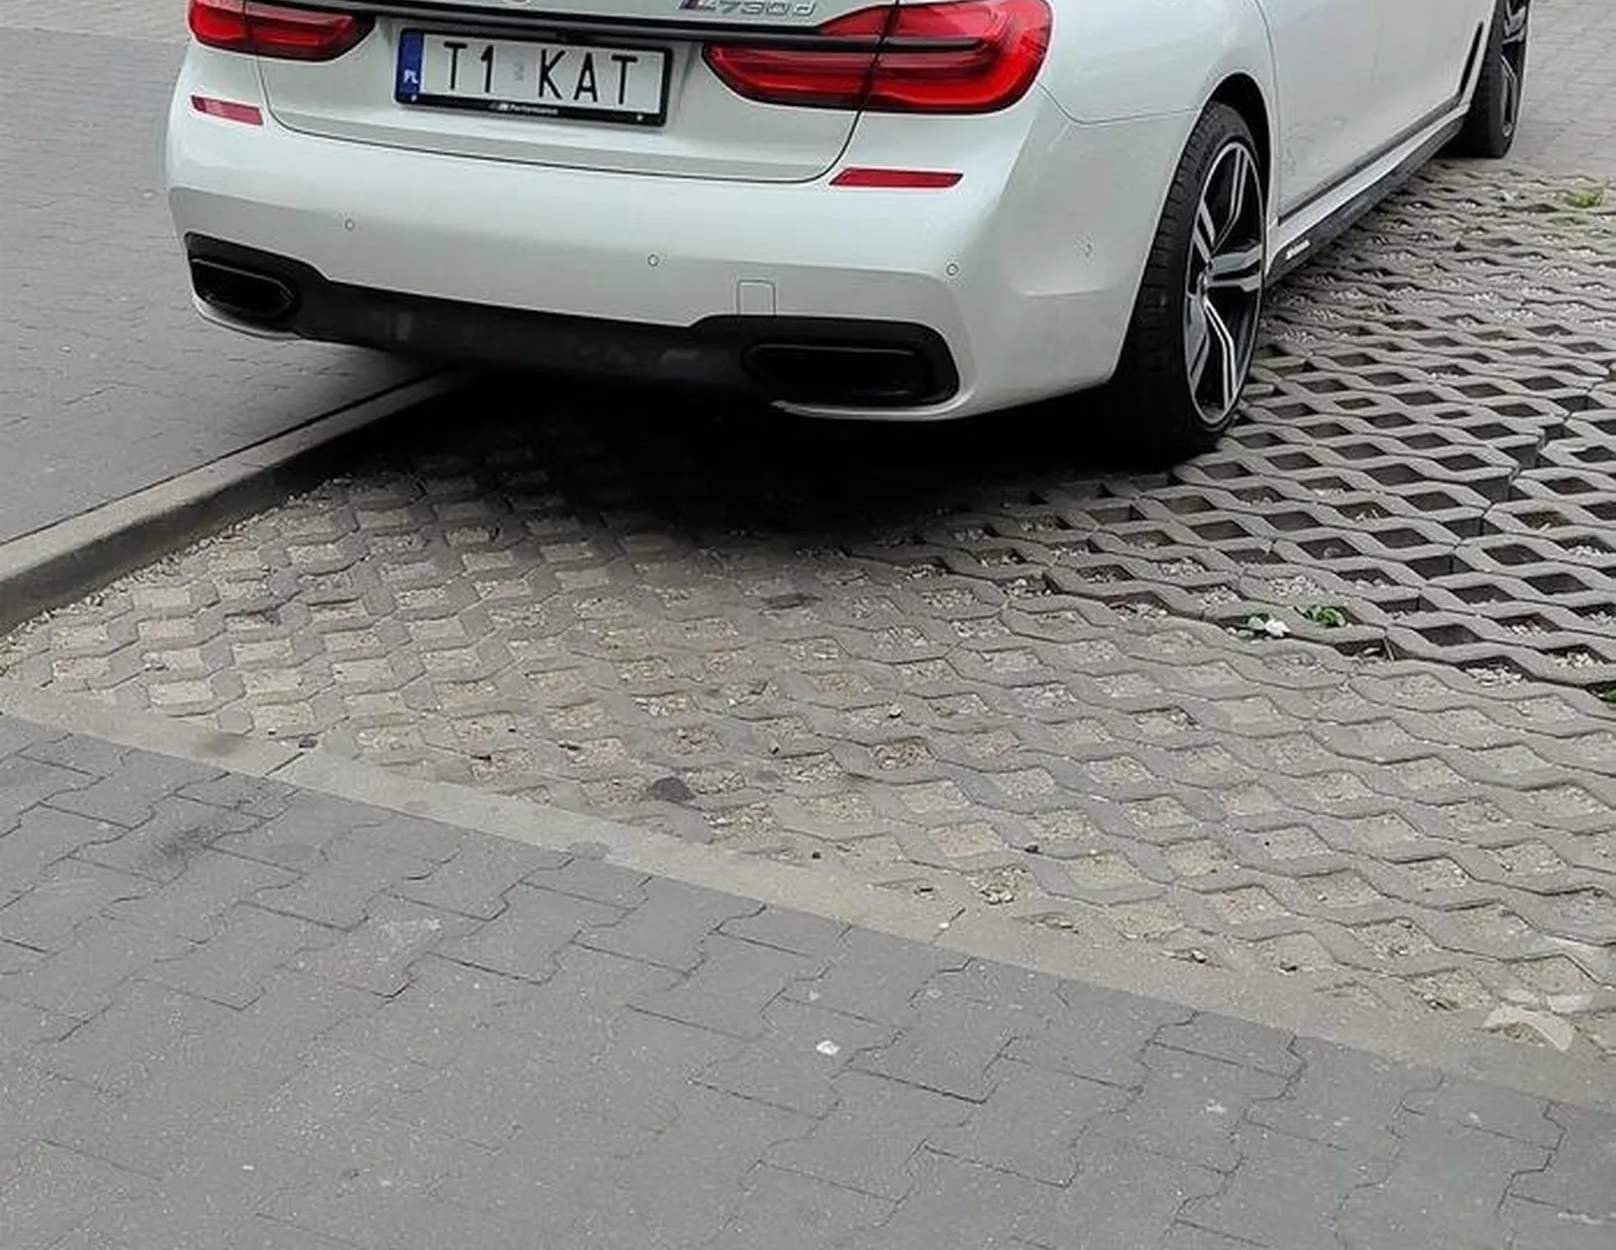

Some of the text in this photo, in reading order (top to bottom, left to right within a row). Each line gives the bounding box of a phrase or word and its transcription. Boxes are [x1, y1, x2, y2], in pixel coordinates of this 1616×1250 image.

[403, 69, 419, 84] PL
[443, 41, 638, 105] T1 KAT
